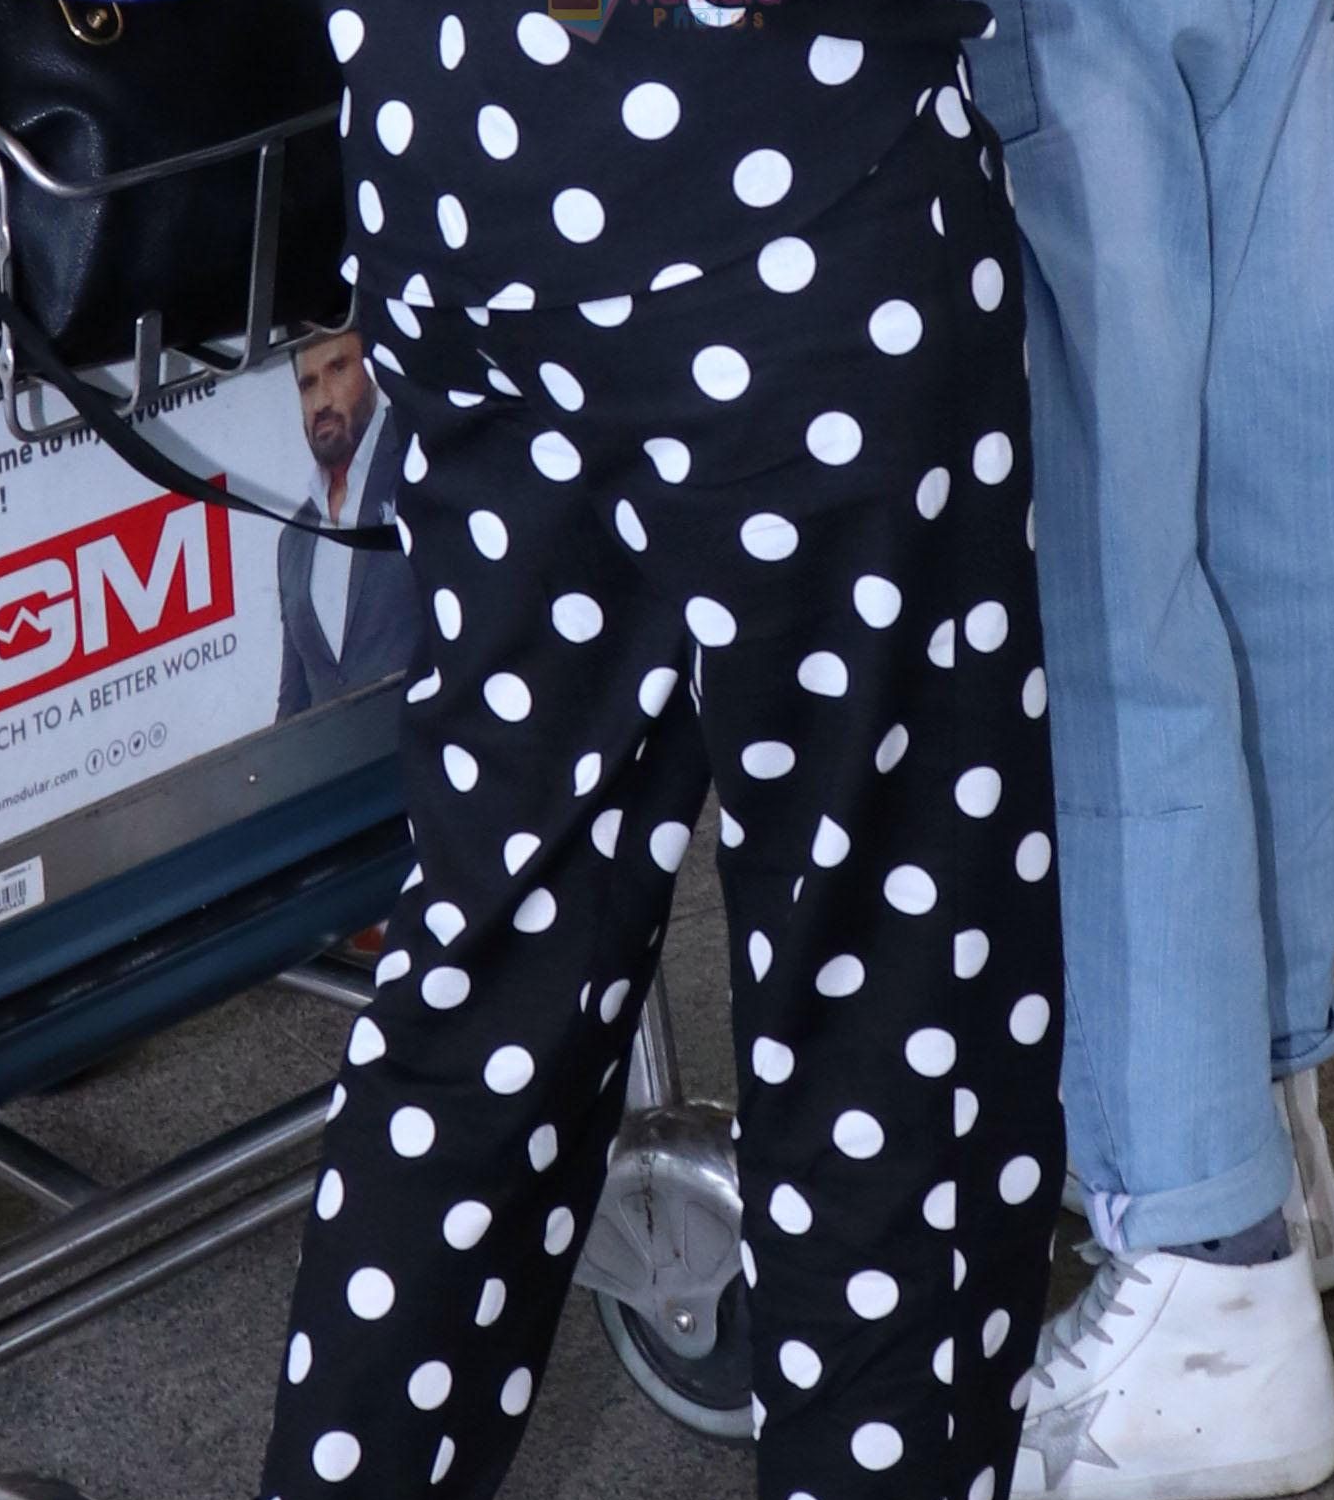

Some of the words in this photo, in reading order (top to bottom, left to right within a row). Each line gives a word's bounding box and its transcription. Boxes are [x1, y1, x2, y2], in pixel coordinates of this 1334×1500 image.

[33, 705, 62, 734] TO
[68, 697, 84, 722] A
[89, 665, 158, 712] BETTER
[162, 632, 238, 680] WORLD
